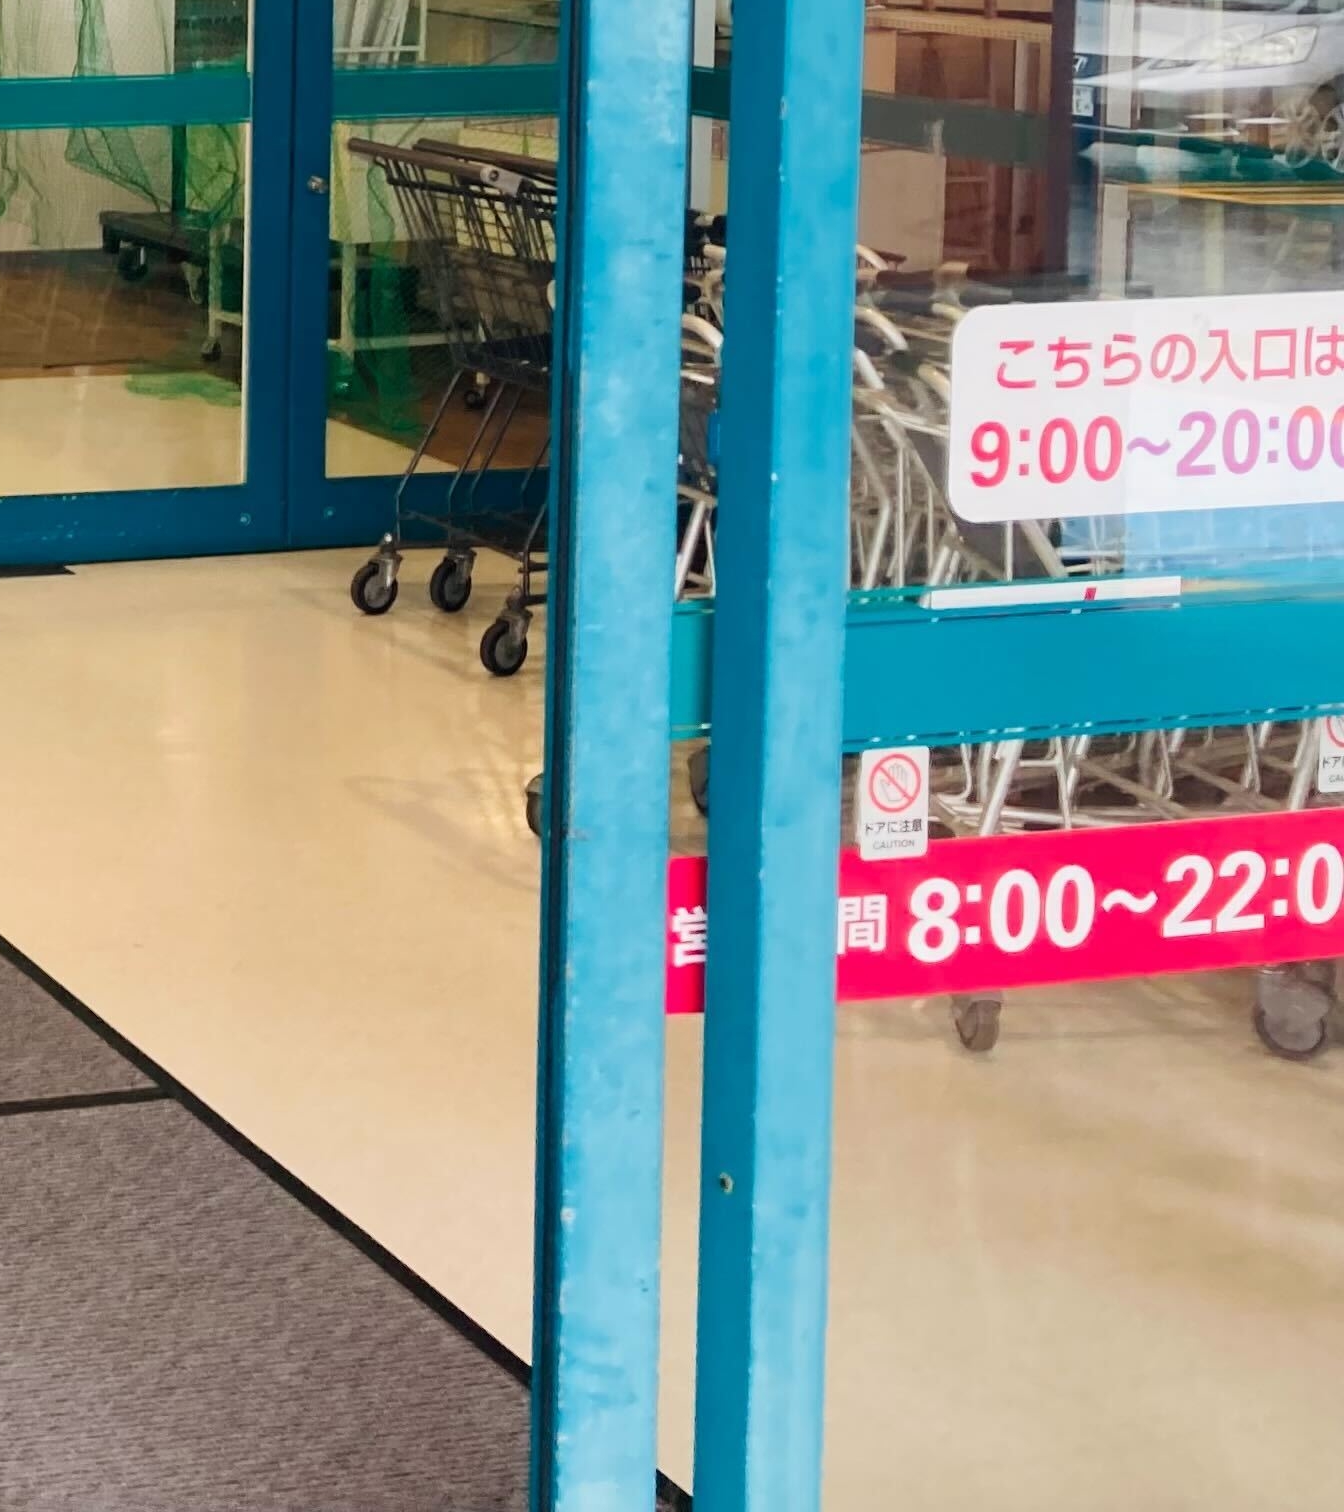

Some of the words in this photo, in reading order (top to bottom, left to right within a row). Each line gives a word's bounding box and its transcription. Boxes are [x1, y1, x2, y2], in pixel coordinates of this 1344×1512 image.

[997, 325, 1344, 389] こちらの入口は
[865, 818, 923, 835] ドアに注意
[872, 839, 915, 851] CAUTION
